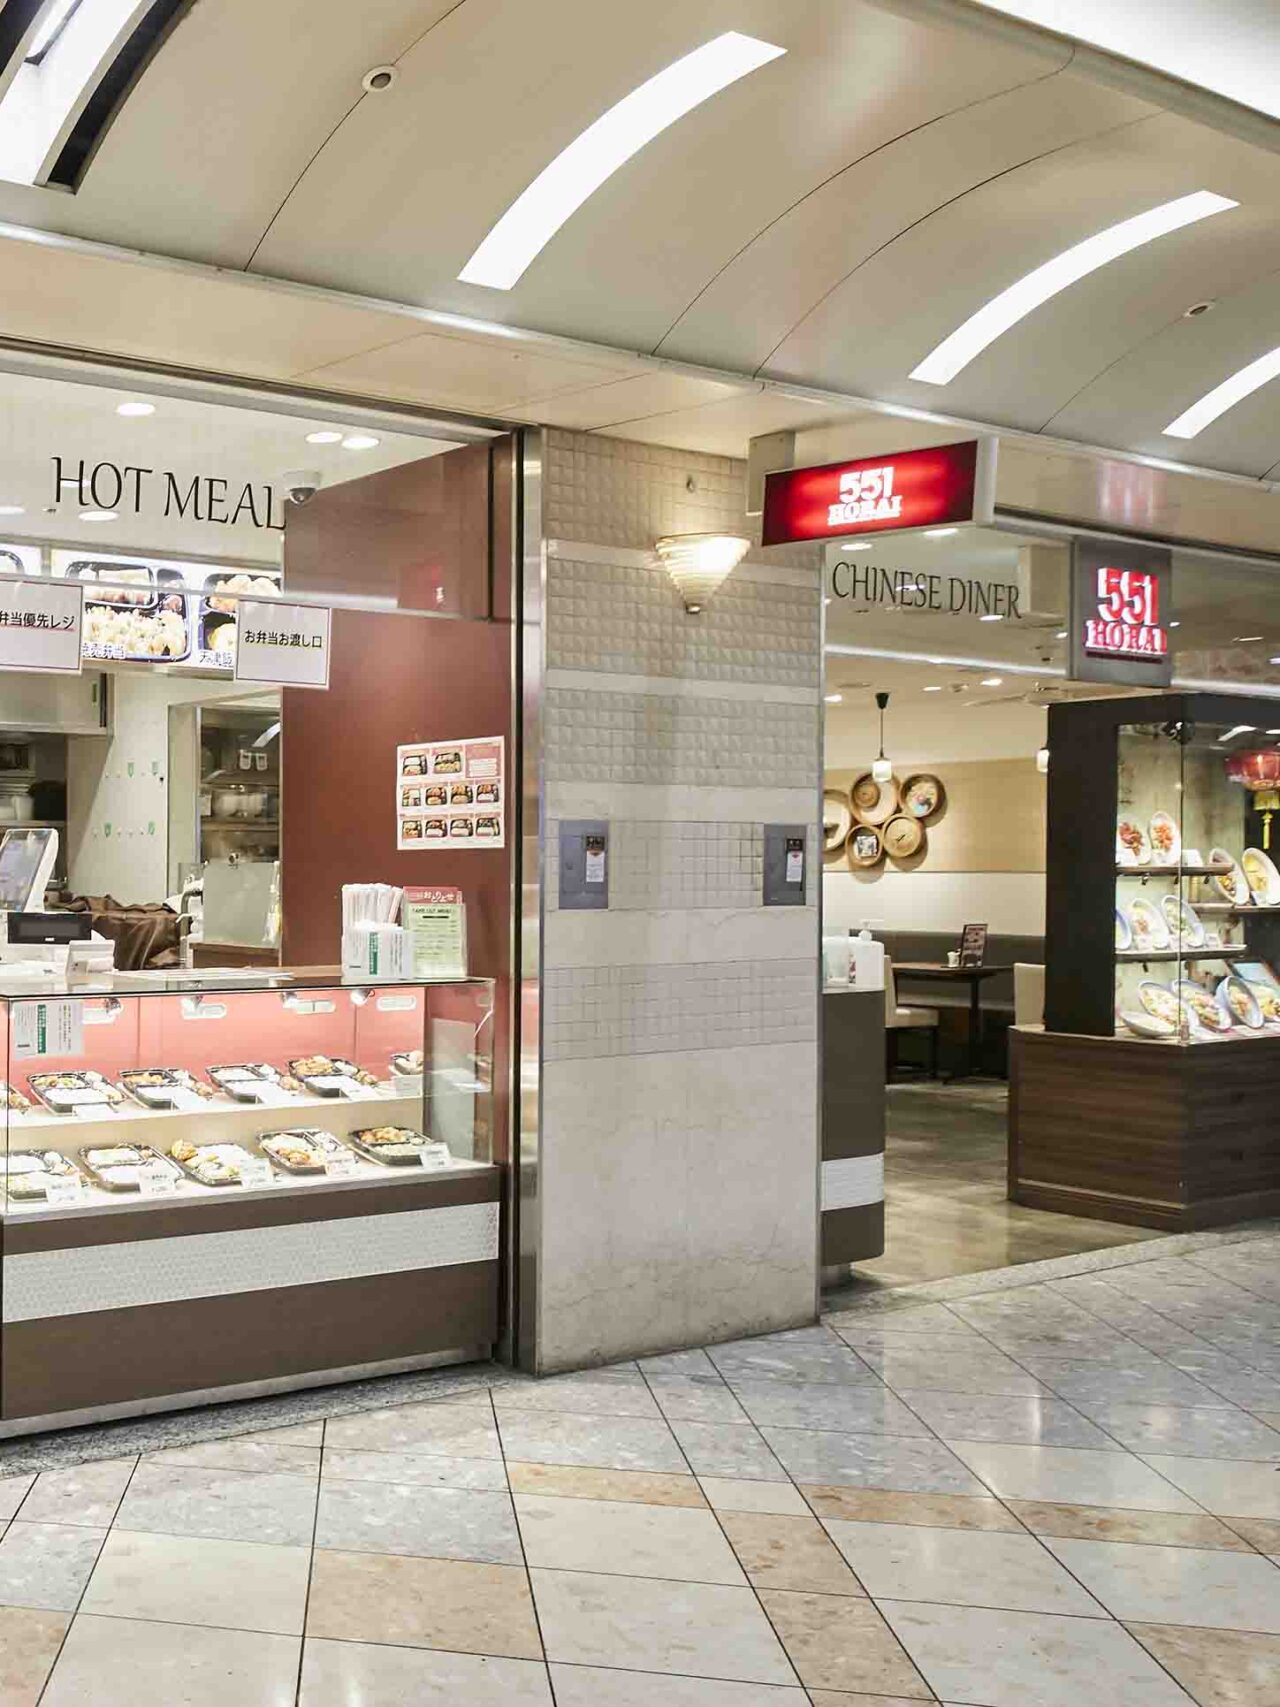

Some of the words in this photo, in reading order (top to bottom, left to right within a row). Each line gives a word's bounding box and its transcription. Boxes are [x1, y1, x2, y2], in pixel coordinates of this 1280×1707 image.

[51, 457, 153, 513] HOT
[163, 472, 287, 531] MEAL
[839, 466, 894, 503] 551
[827, 495, 902, 526] HORAI
[832, 562, 941, 610] CHINESE
[948, 577, 1022, 619] DINER
[1098, 567, 1159, 626] 551
[244, 630, 323, 649] お弁当お渡し口
